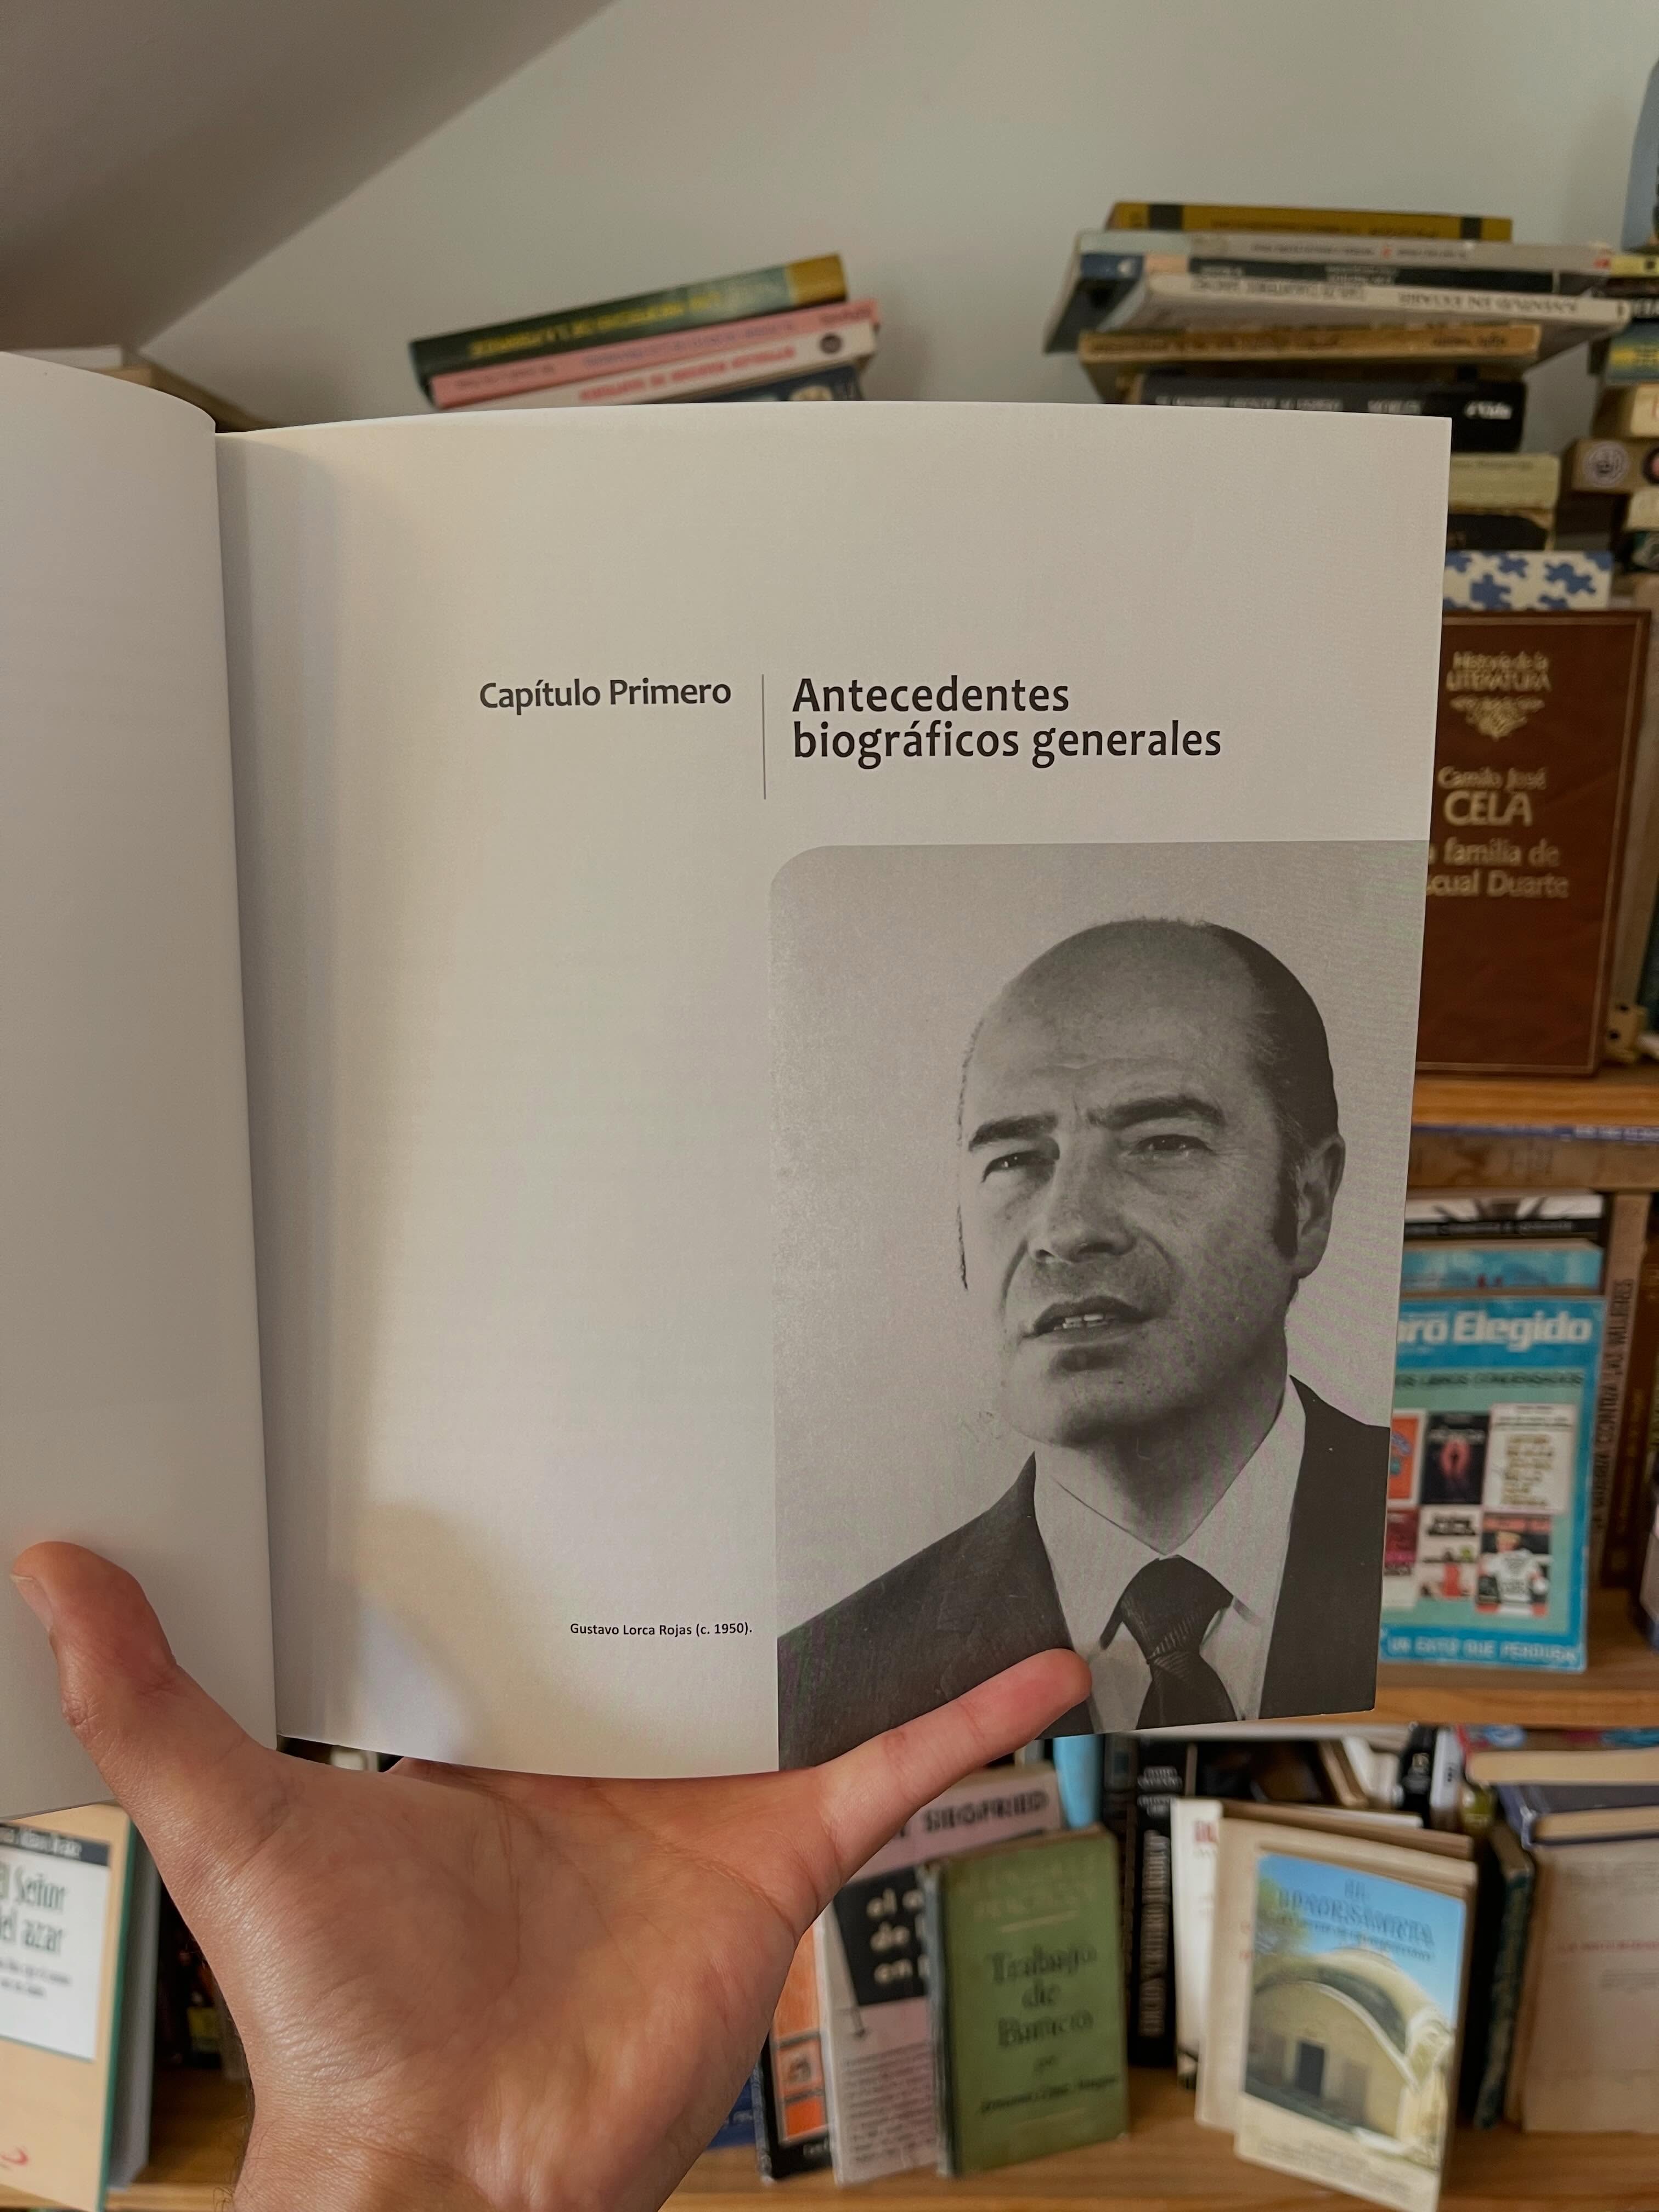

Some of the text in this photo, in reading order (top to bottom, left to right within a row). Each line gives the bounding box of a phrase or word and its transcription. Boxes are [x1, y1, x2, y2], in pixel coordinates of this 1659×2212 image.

[479, 677, 731, 716] Capítulo Primero
[792, 674, 1069, 713] Antecedentes
[793, 719, 1221, 770] biográficos generales
[1438, 766, 1503, 789] Camilo
[1444, 790, 1533, 826] CELA
[1443, 836, 1522, 867] familia
[1528, 838, 1560, 867] de
[1486, 870, 1569, 899] Duarte
[1451, 1311, 1592, 1352] Elegido
[570, 1621, 752, 1638] Gustavo Lorca Rojas (c. 1950).
[923, 1790, 1049, 1833] SIEGFRIED
